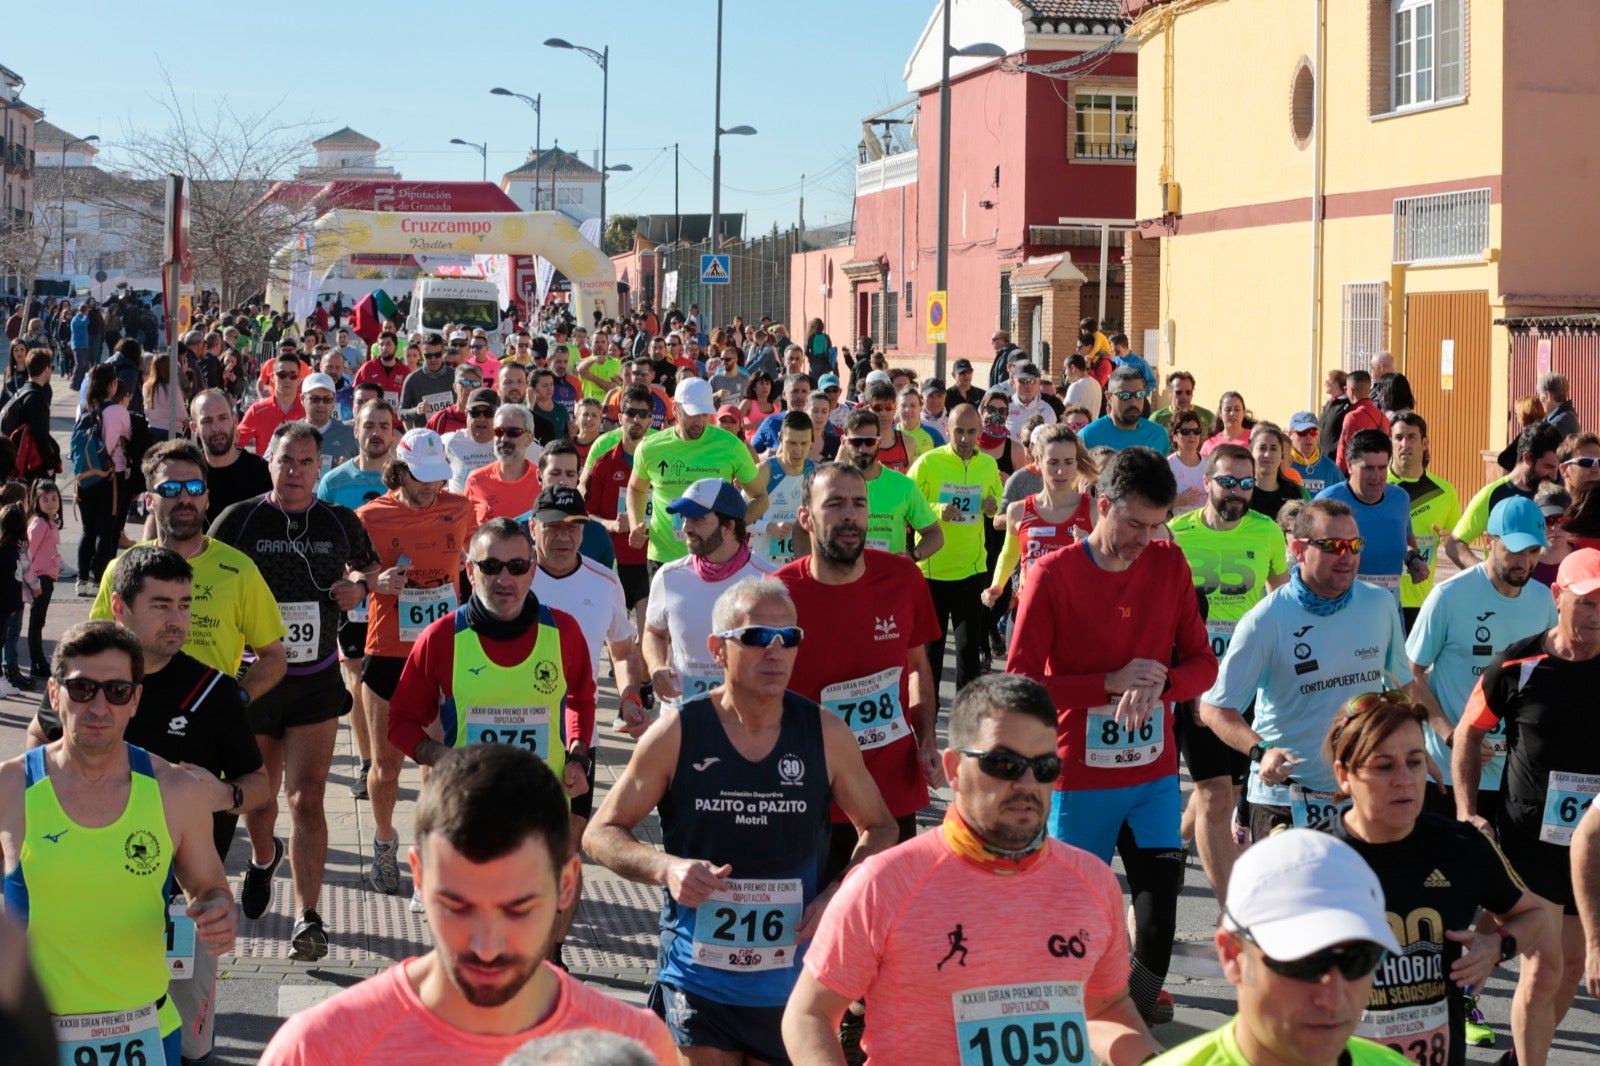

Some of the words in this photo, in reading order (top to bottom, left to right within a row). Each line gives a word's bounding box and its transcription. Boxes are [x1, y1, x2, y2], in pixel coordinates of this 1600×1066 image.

[399, 189, 452, 201] Diputación
[399, 201, 410, 211] de
[411, 201, 452, 211] Granada
[401, 217, 492, 235] Cruzcampo
[409, 237, 453, 251] Radler
[951, 497, 971, 512] 82
[838, 692, 894, 728] 798
[782, 759, 800, 774] 30
[695, 799, 745, 812] PAZITO
[747, 804, 757, 813] a
[759, 800, 808, 813] PAZITO
[735, 814, 768, 825] Motril
[743, 882, 767, 892] PREMIO
[768, 883, 776, 892] DE
[733, 893, 771, 902] DIPUTACIÓN
[713, 907, 785, 942] 216
[1048, 934, 1086, 958] GO
[987, 990, 1011, 1001] GRAN
[1012, 987, 1042, 999] PREMIO
[1043, 986, 1053, 997] DE
[1368, 987, 1388, 1006] AN
[1001, 1000, 1050, 1015] DIPUTACIÓN
[81, 1017, 100, 1028] GRAN
[101, 1014, 126, 1026] PREMIO
[126, 1012, 134, 1021] DE
[91, 1024, 130, 1038] DIPUTACIÓN
[969, 1021, 1084, 1066] 1050
[74, 1038, 148, 1066] 976
